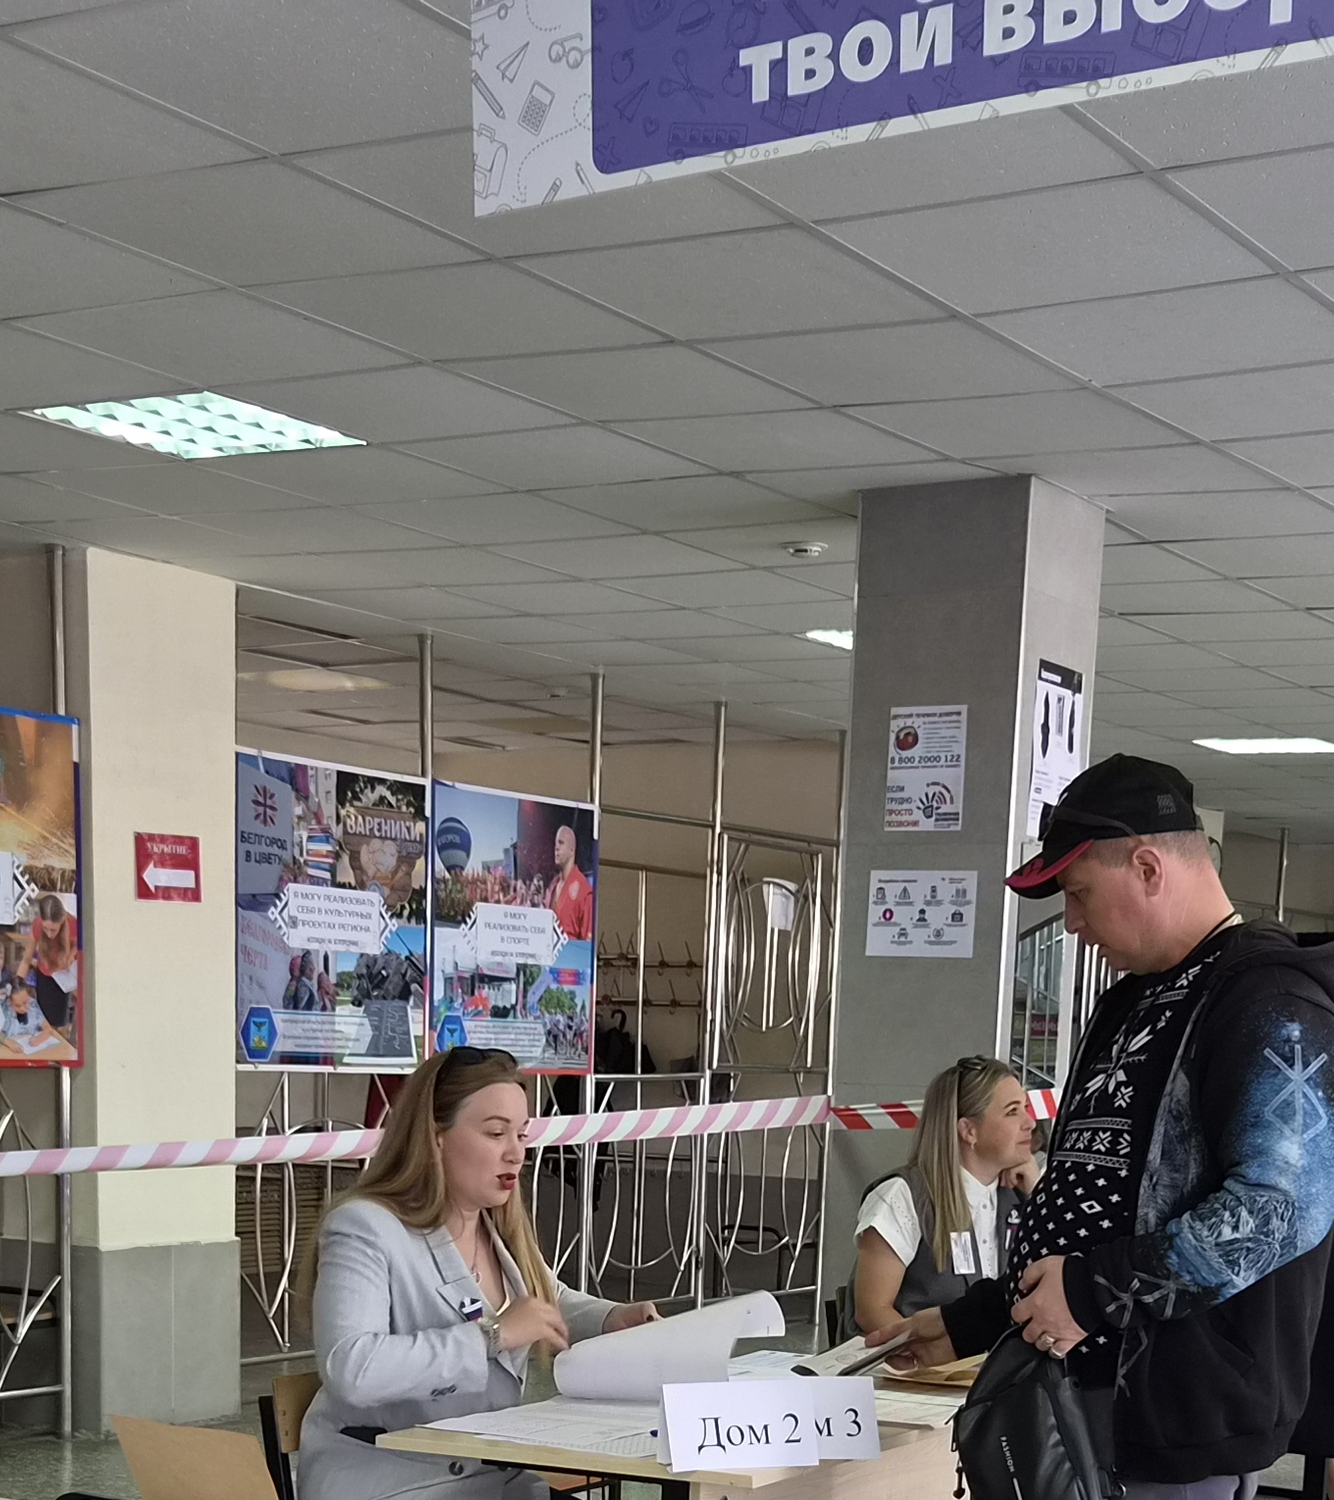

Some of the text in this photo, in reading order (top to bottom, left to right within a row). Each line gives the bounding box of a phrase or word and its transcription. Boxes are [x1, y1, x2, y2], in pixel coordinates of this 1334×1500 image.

[898, 756, 915, 764] 800
[918, 755, 941, 764] 2000
[945, 754, 961, 763] 122
[346, 815, 421, 841] ВАРЕНИКИ
[240, 831, 287, 851] БЕЛГОРОД
[245, 853, 252, 863] В
[844, 1407, 862, 1437] 3
[698, 1413, 802, 1455] Дом 2
